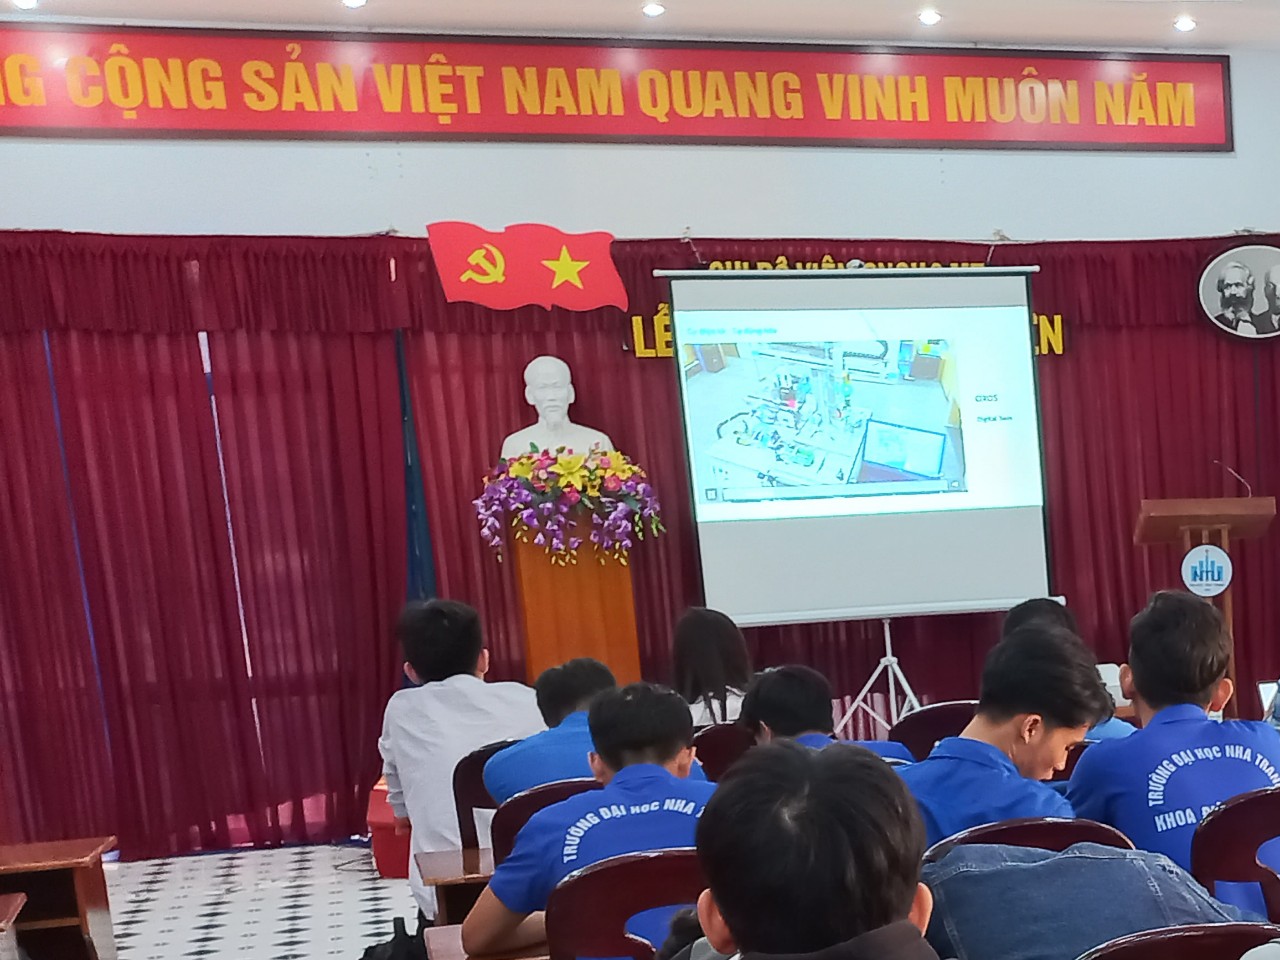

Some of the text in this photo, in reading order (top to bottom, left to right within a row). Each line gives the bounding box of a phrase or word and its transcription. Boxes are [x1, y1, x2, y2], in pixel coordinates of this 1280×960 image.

[0, 43, 1196, 127] G CỘNG SẢN VIỆT NAM QUANG VINH MUÔN NĂM
[1148, 760, 1178, 807] TRƯỜNG
[1171, 749, 1196, 766] ĐẠI
[1194, 745, 1222, 760] HỌC
[1225, 744, 1252, 762] NHA
[563, 812, 601, 864] TRƯỜNG
[663, 798, 696, 815] NHA
[1154, 807, 1198, 833] KHOA
